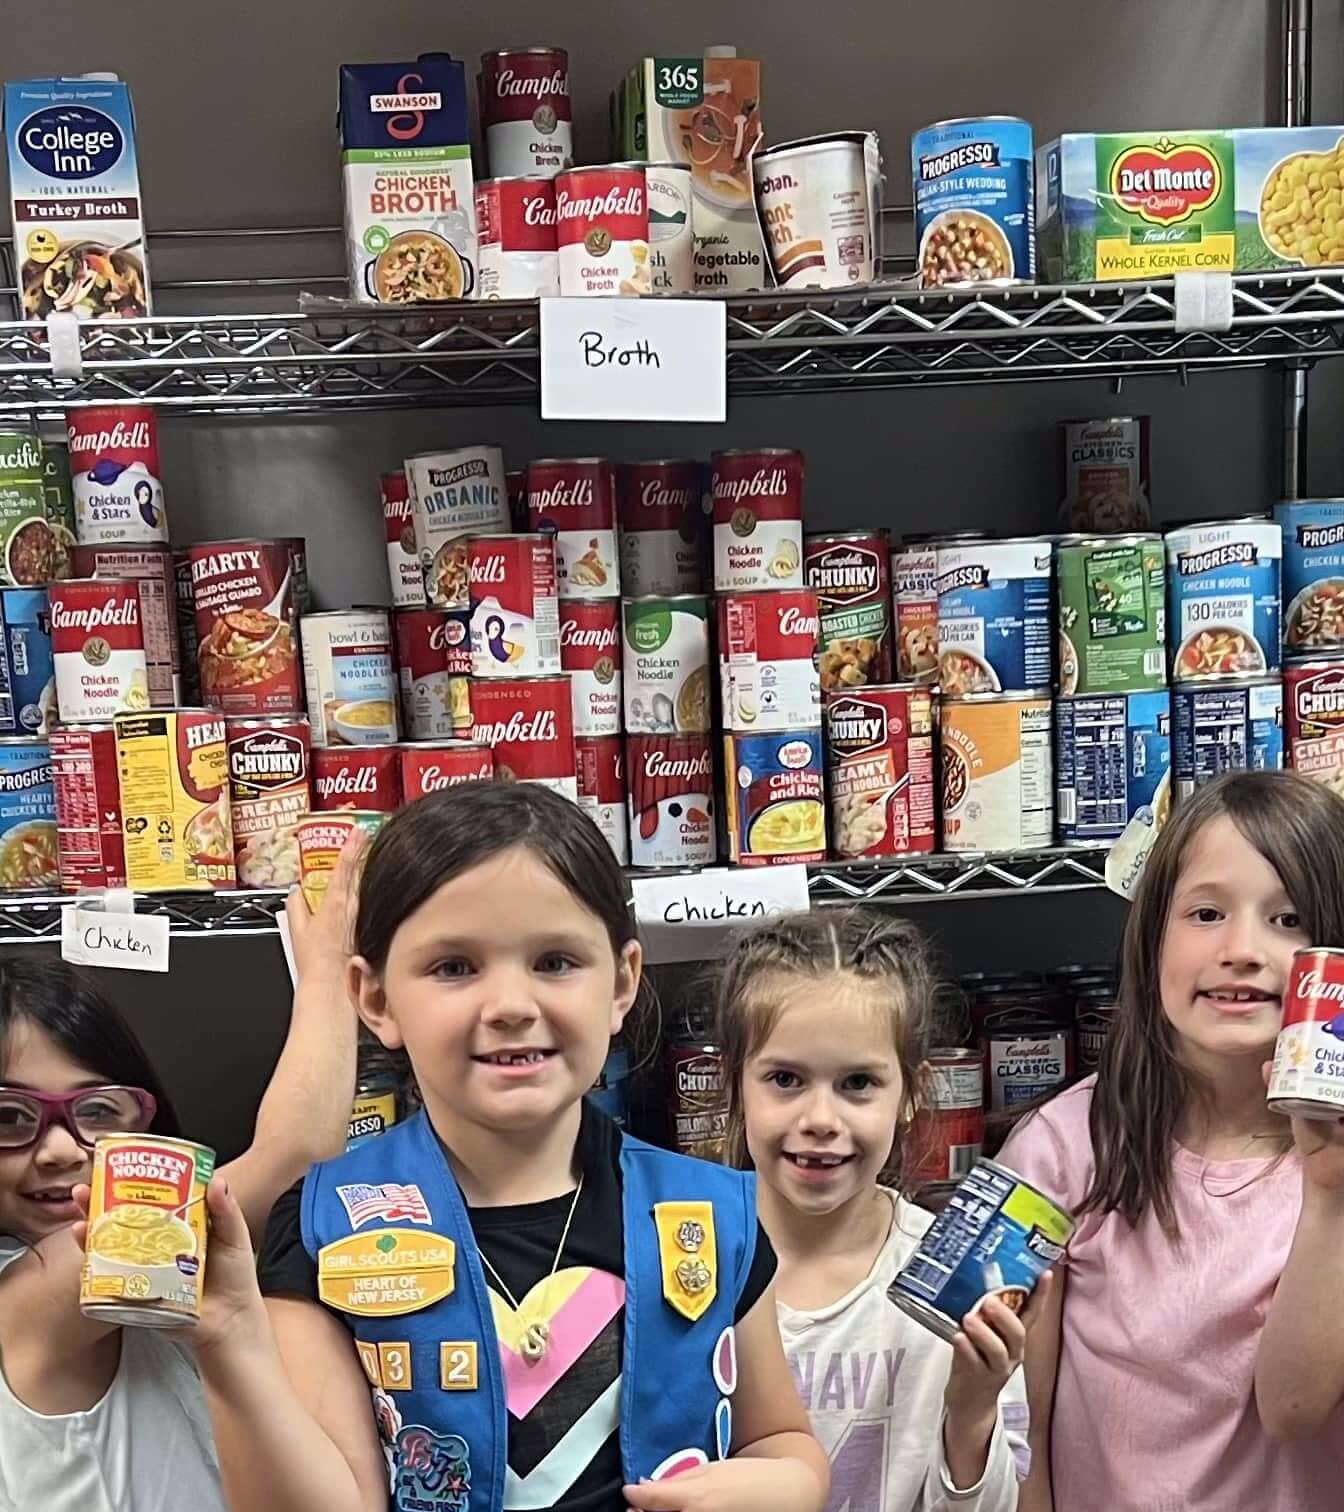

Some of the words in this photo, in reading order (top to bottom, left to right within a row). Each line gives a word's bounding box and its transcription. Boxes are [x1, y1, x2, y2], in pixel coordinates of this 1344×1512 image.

[659, 65, 698, 91] 365
[375, 95, 437, 108] SWANSON
[25, 126, 114, 155] College
[53, 150, 91, 172] Inn
[922, 144, 992, 180] PROGRESSO
[374, 175, 451, 192] CHICKEN
[1120, 169, 1152, 192] Del
[1153, 168, 1211, 191] Monte
[66, 185, 108, 194] NATURAL
[26, 204, 80, 218] Turkey
[85, 202, 127, 216] Broth
[370, 190, 458, 214] BROTH
[556, 186, 643, 223] Campbell's
[1145, 195, 1186, 210] Quality
[1101, 253, 1145, 269] WHOLE
[1149, 253, 1192, 267] KERNEL
[1194, 250, 1231, 266] CORN
[580, 266, 619, 278] Chicken
[586, 279, 614, 291] Broth
[579, 331, 661, 369] Broth
[67, 421, 150, 455] Campbell's
[1072, 446, 1135, 462] CLASSICS
[433, 460, 484, 487] PROGRESSO
[88, 494, 131, 507] Chicken
[424, 485, 499, 514] ORGANIC
[100, 506, 131, 520] Stars
[99, 529, 126, 540] SOUP
[1198, 531, 1231, 544] LIGHT
[727, 545, 763, 556] Chicken
[1180, 544, 1253, 574] PROGRESSO
[191, 550, 260, 582] HEARTY
[729, 557, 762, 569] Noodle
[1303, 555, 1340, 568] CHICKEN
[808, 567, 876, 587] CHUNKY
[1182, 578, 1216, 592] CHICKEN
[1217, 576, 1251, 590] NOODLE
[50, 598, 138, 632] Campbell's
[1186, 602, 1210, 621] 130
[1211, 600, 1248, 610] CALORIES
[328, 630, 358, 644] bowl
[636, 657, 680, 669] Chicken
[80, 674, 119, 686] Chicken
[340, 669, 378, 679] NOODLE
[637, 669, 674, 680] Noodle
[83, 687, 119, 698] Noodle
[231, 752, 301, 775] CHUNKY
[1297, 754, 1340, 772] CHICKEN
[770, 786, 795, 800] and
[232, 793, 307, 820] CREAMY
[663, 891, 766, 923] Chicken
[83, 925, 153, 955] Chicken
[997, 1063, 1061, 1078] CLASSICS
[107, 1150, 188, 1175] CHICKEN
[111, 1165, 181, 1185] NOODLE
[325, 1255, 357, 1268] GIRL
[359, 1251, 416, 1266] SCOUTS
[419, 1248, 449, 1262] USA
[354, 1278, 396, 1291] HEART
[399, 1275, 417, 1288] OF
[348, 1291, 380, 1305] NEW
[380, 1287, 425, 1302] JERSEY
[790, 1347, 908, 1409] NAVY
